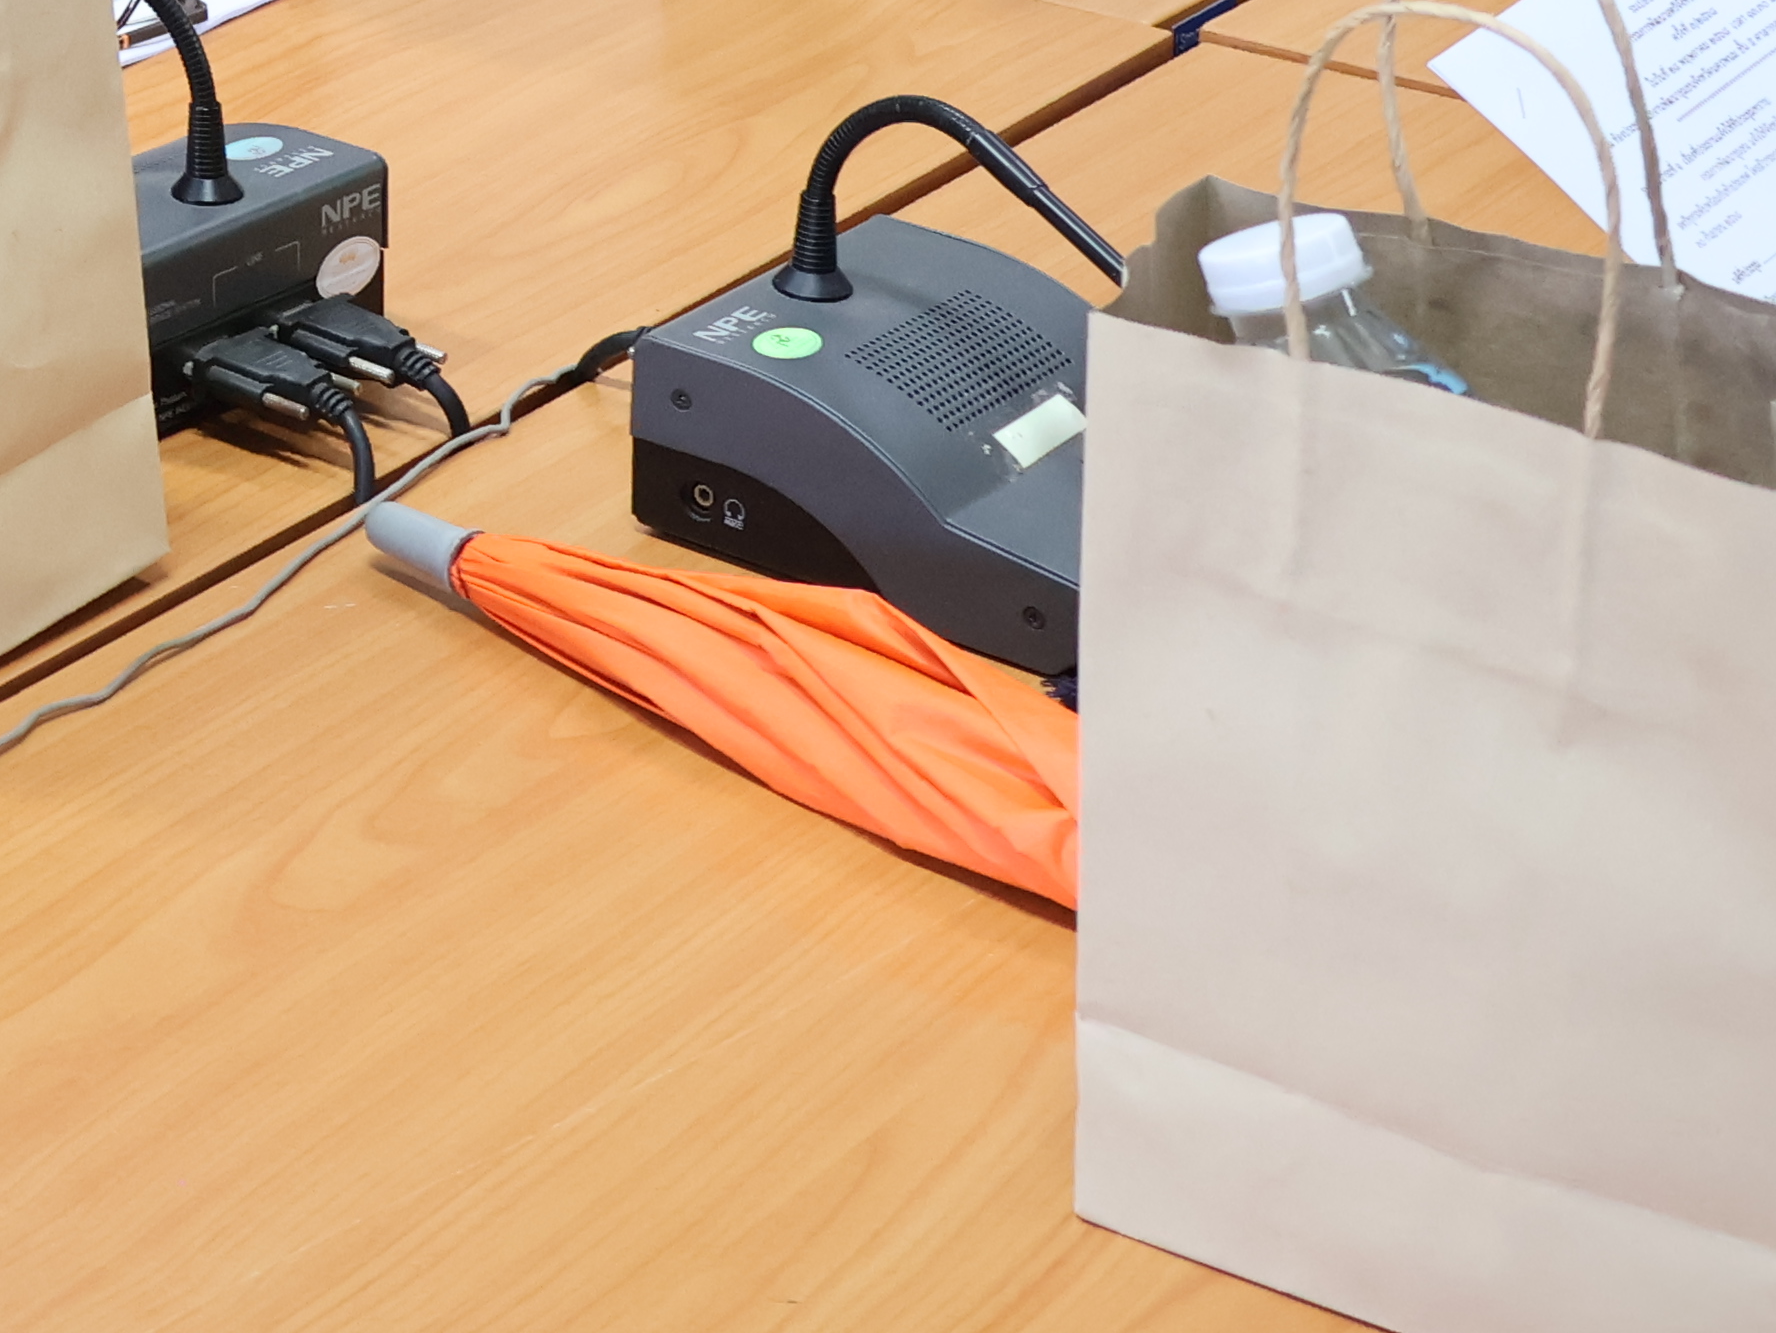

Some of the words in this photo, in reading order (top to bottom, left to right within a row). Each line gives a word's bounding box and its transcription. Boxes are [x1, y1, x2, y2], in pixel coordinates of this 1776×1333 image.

[267, 145, 335, 179] NPE
[320, 183, 382, 228] NPE
[692, 305, 767, 342] NPE
